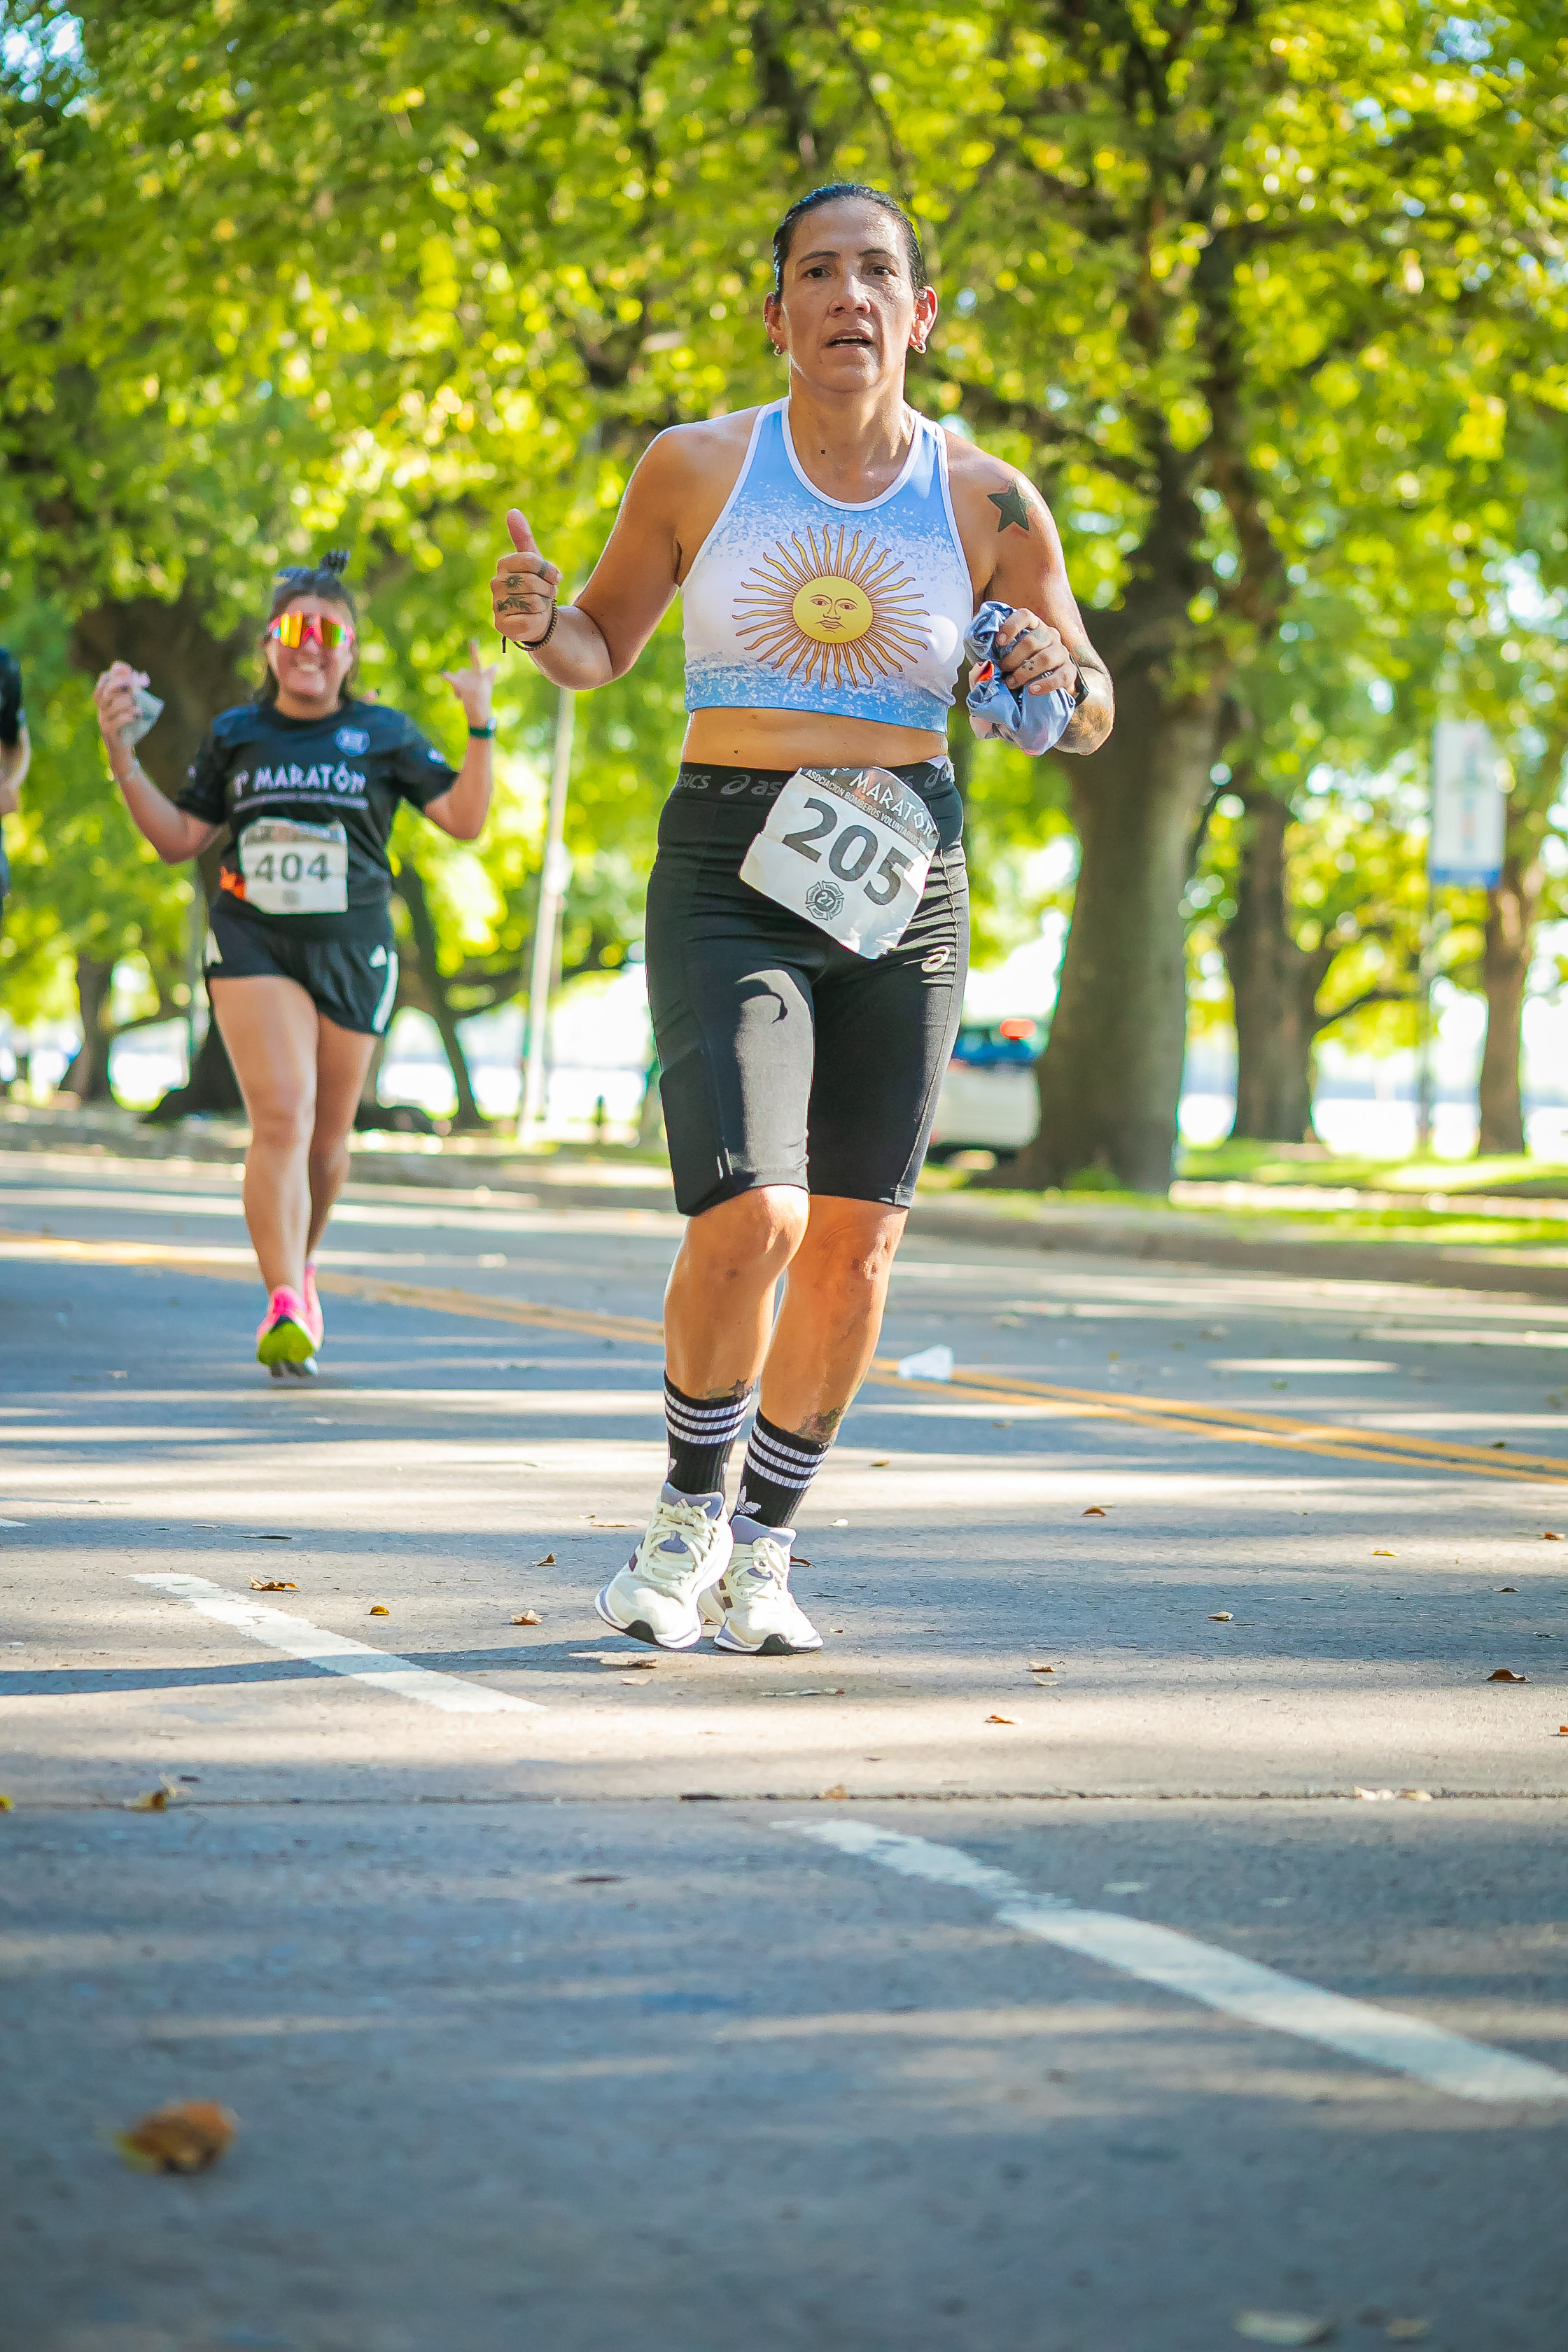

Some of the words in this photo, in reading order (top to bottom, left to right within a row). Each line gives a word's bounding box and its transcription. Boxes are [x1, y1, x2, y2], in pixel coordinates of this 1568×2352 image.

[253, 760, 367, 794] MARATÓN
[844, 791, 881, 818] BOMBEROS
[881, 813, 920, 845] VOLUNTARIOS
[849, 771, 939, 839] MARATÓN
[255, 852, 331, 883] 404
[781, 797, 914, 906] 205
[816, 891, 834, 907] 27
